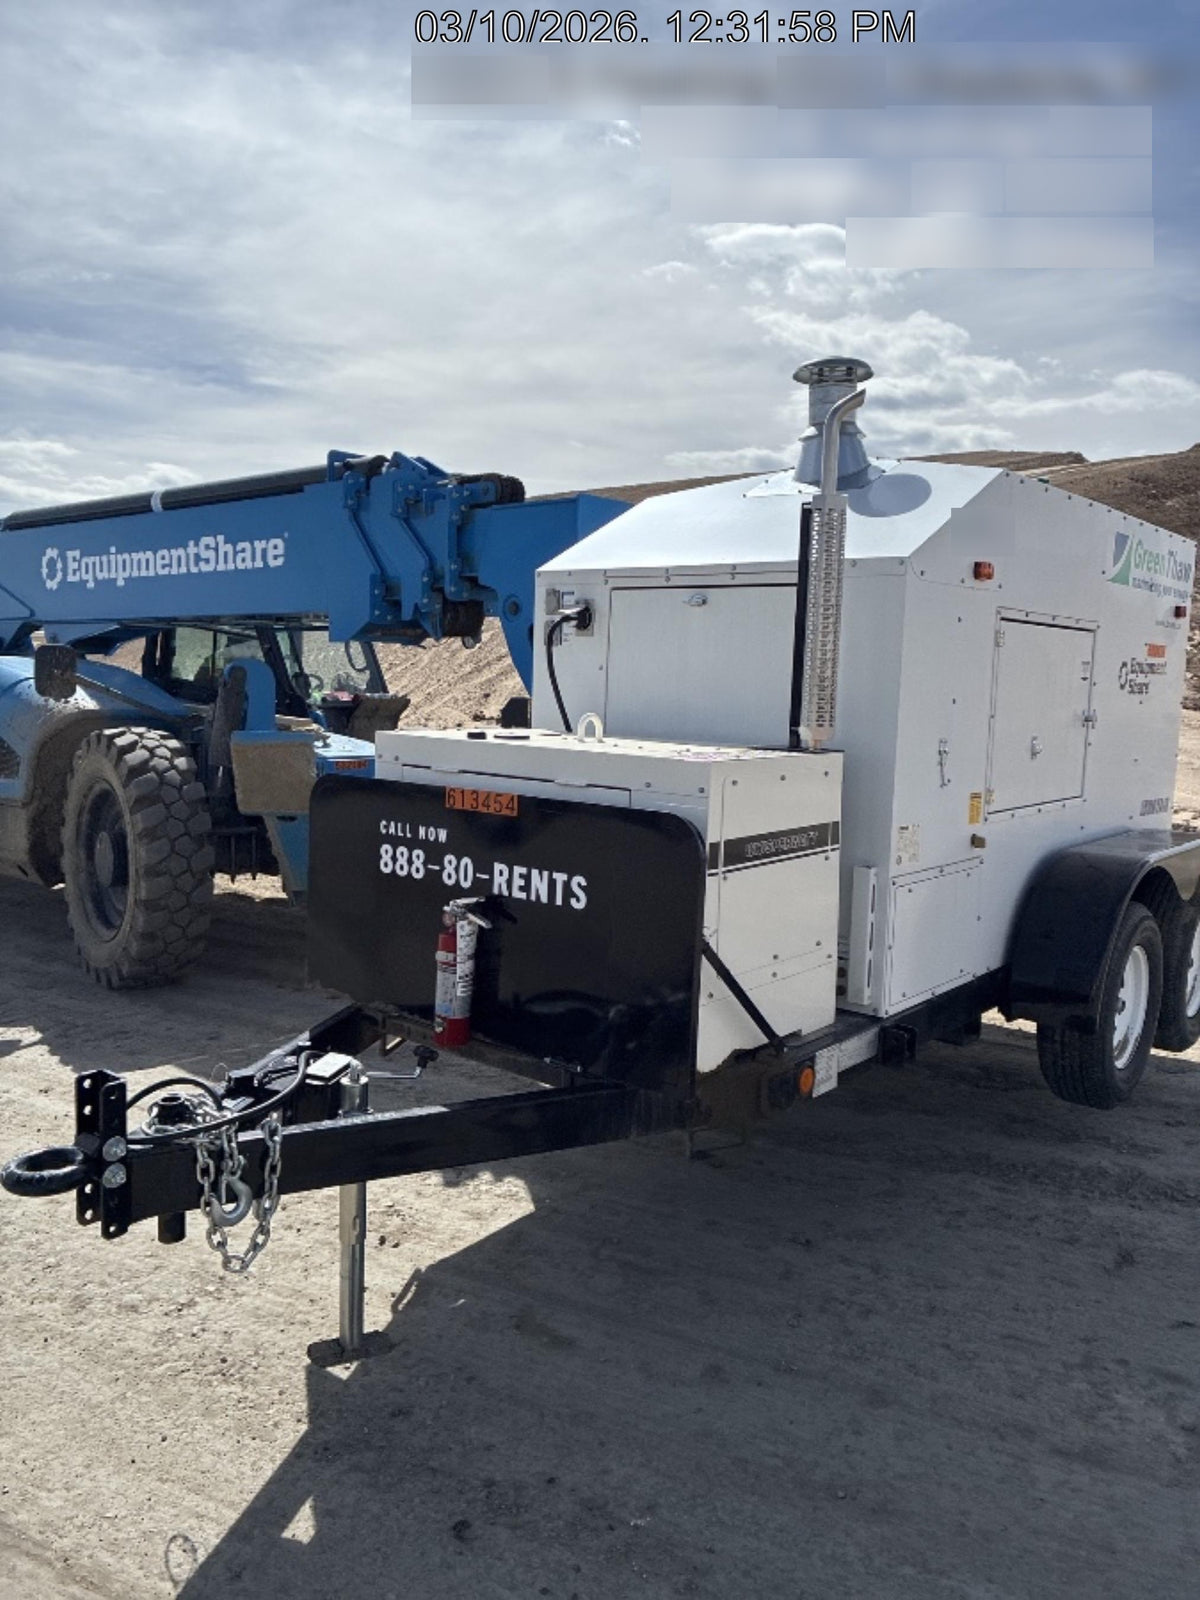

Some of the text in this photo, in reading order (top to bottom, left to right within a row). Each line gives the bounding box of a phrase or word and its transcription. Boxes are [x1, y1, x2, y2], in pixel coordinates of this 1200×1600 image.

[66, 534, 285, 589] EquipmentShare
[447, 787, 515, 813] 613454
[379, 820, 448, 843] CALL NOW
[379, 844, 588, 910] 888-80-RENTS
